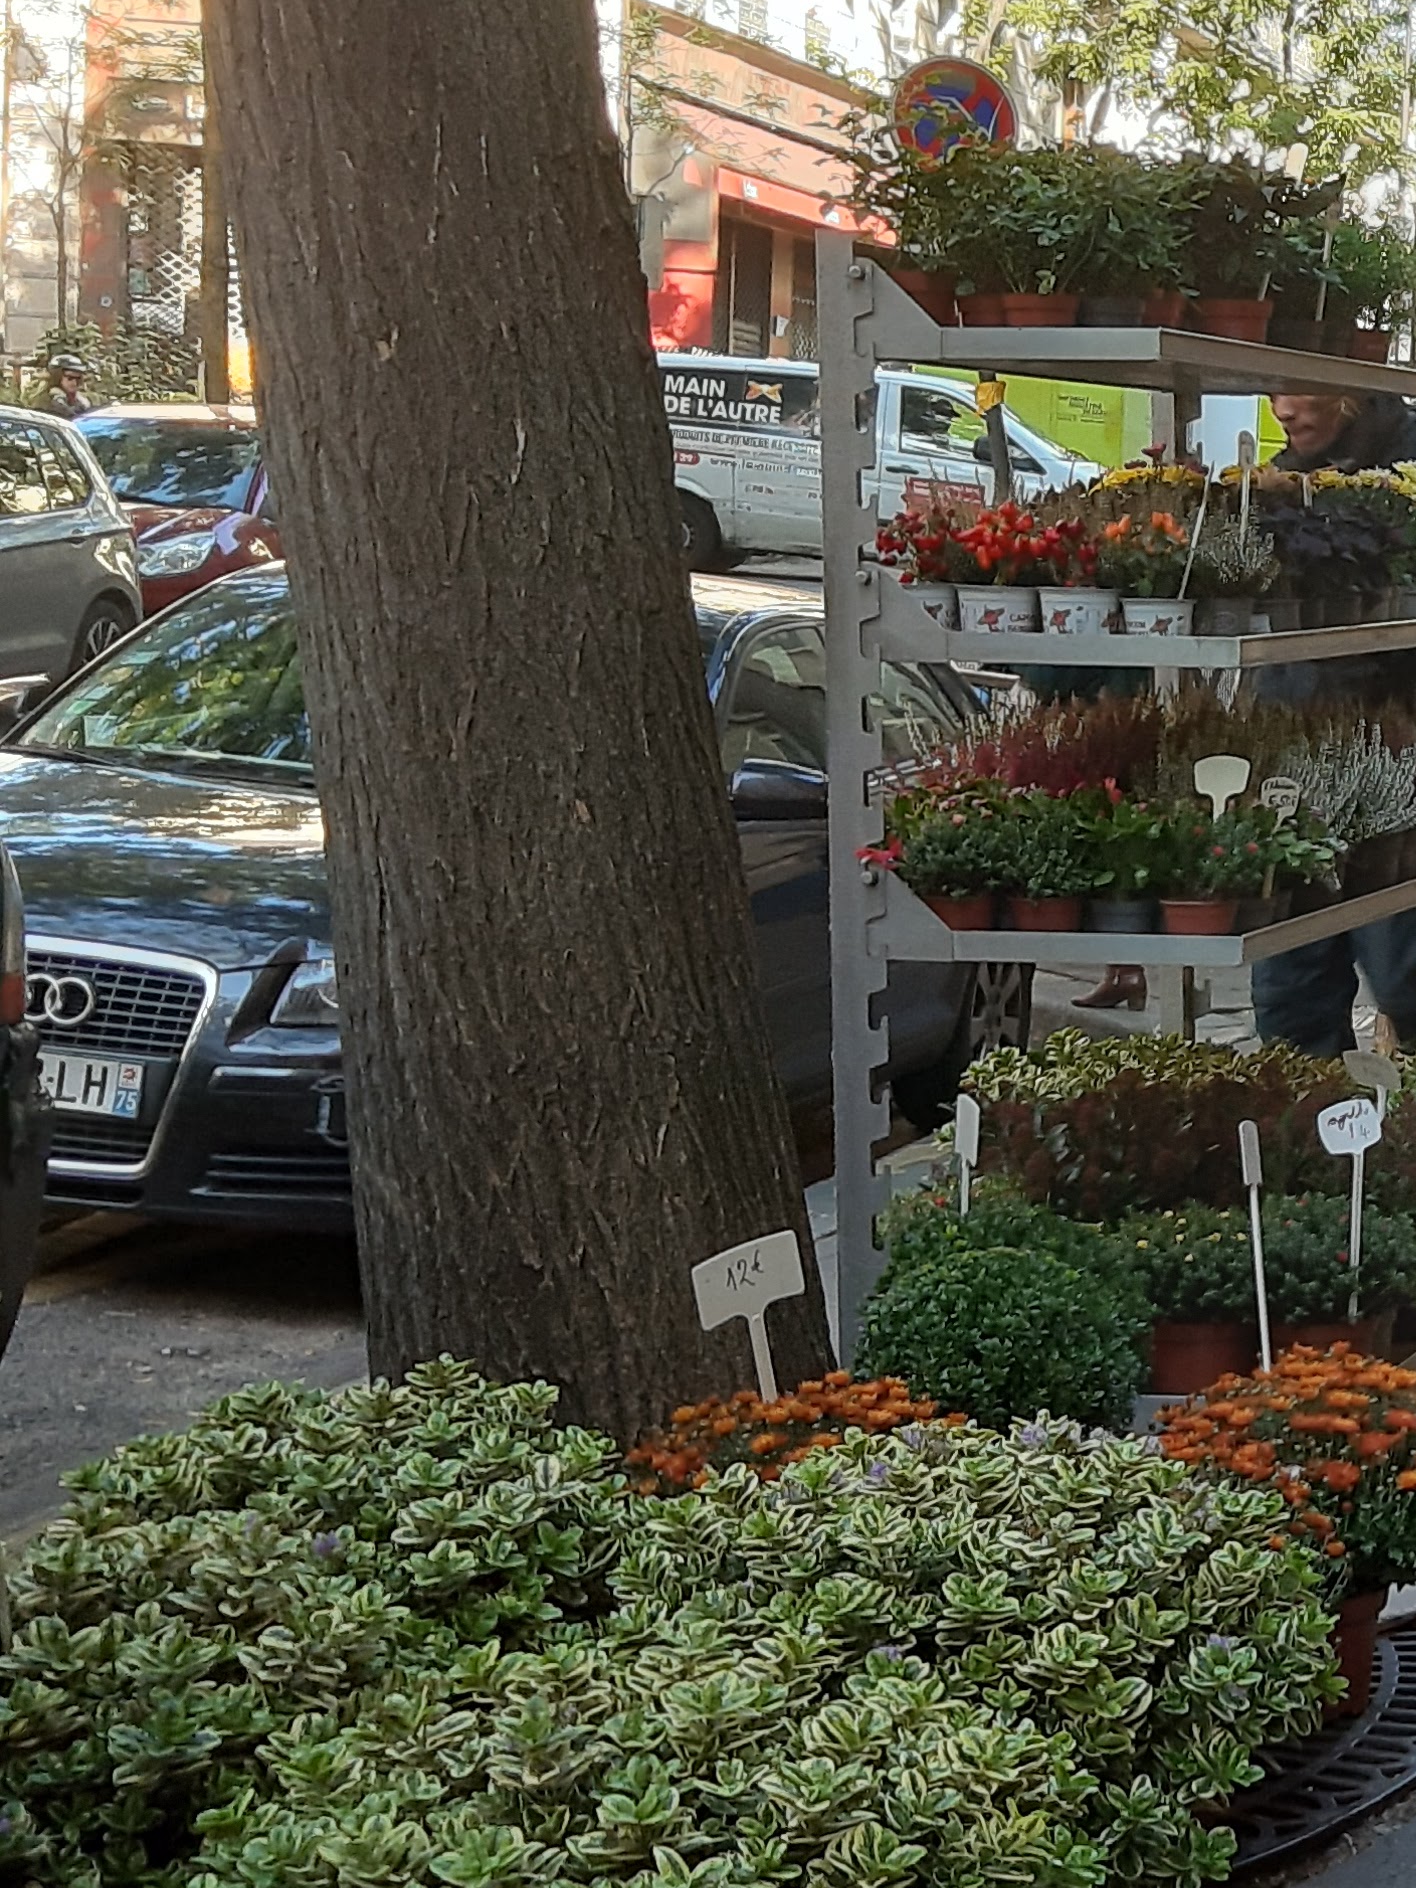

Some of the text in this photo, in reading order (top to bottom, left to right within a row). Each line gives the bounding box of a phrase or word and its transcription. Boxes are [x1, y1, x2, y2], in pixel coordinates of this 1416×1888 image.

[663, 374, 726, 399] MAIN
[663, 395, 782, 425] DE L'AUTRE
[115, 1090, 138, 1111] 75
